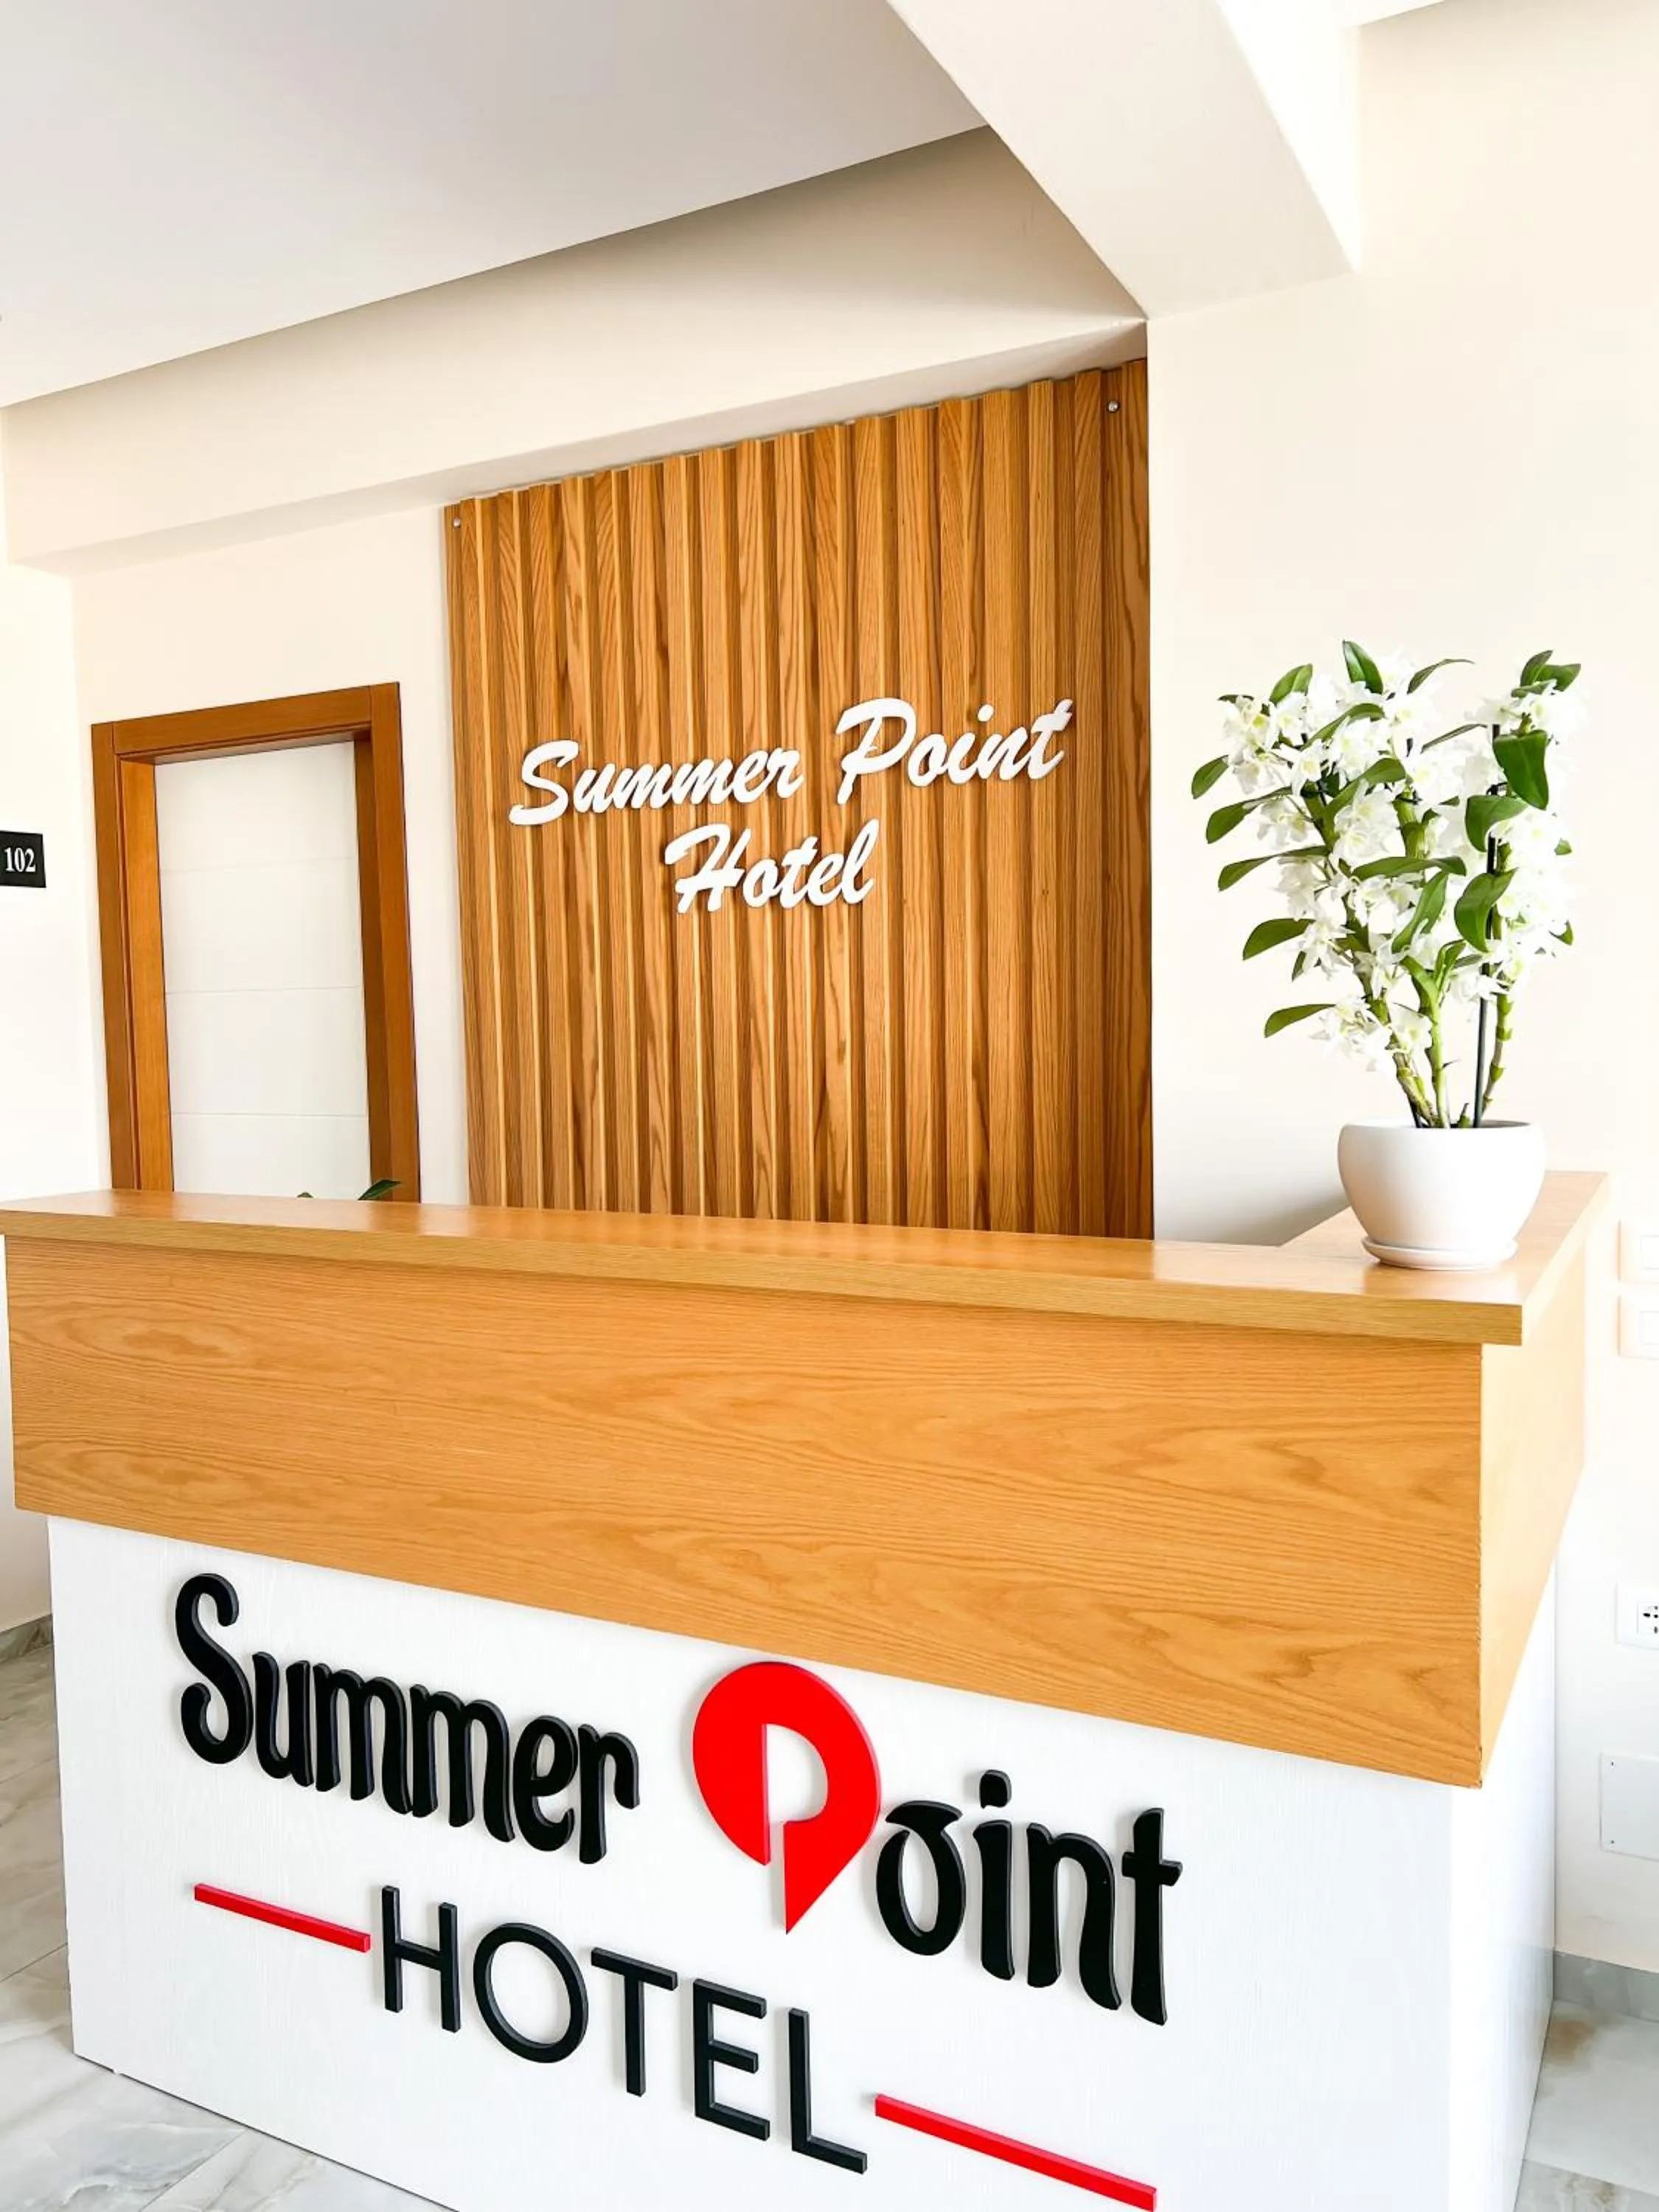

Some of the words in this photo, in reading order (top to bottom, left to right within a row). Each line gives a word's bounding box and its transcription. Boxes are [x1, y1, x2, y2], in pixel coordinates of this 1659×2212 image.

[509, 740, 804, 825] Summer
[835, 698, 1073, 804] Point
[4, 847, 36, 872] 102
[664, 818, 880, 914] Hotel
[175, 1573, 640, 1864] Summer
[692, 1660, 1183, 2025] Point
[382, 1885, 867, 2174] HOTEL
